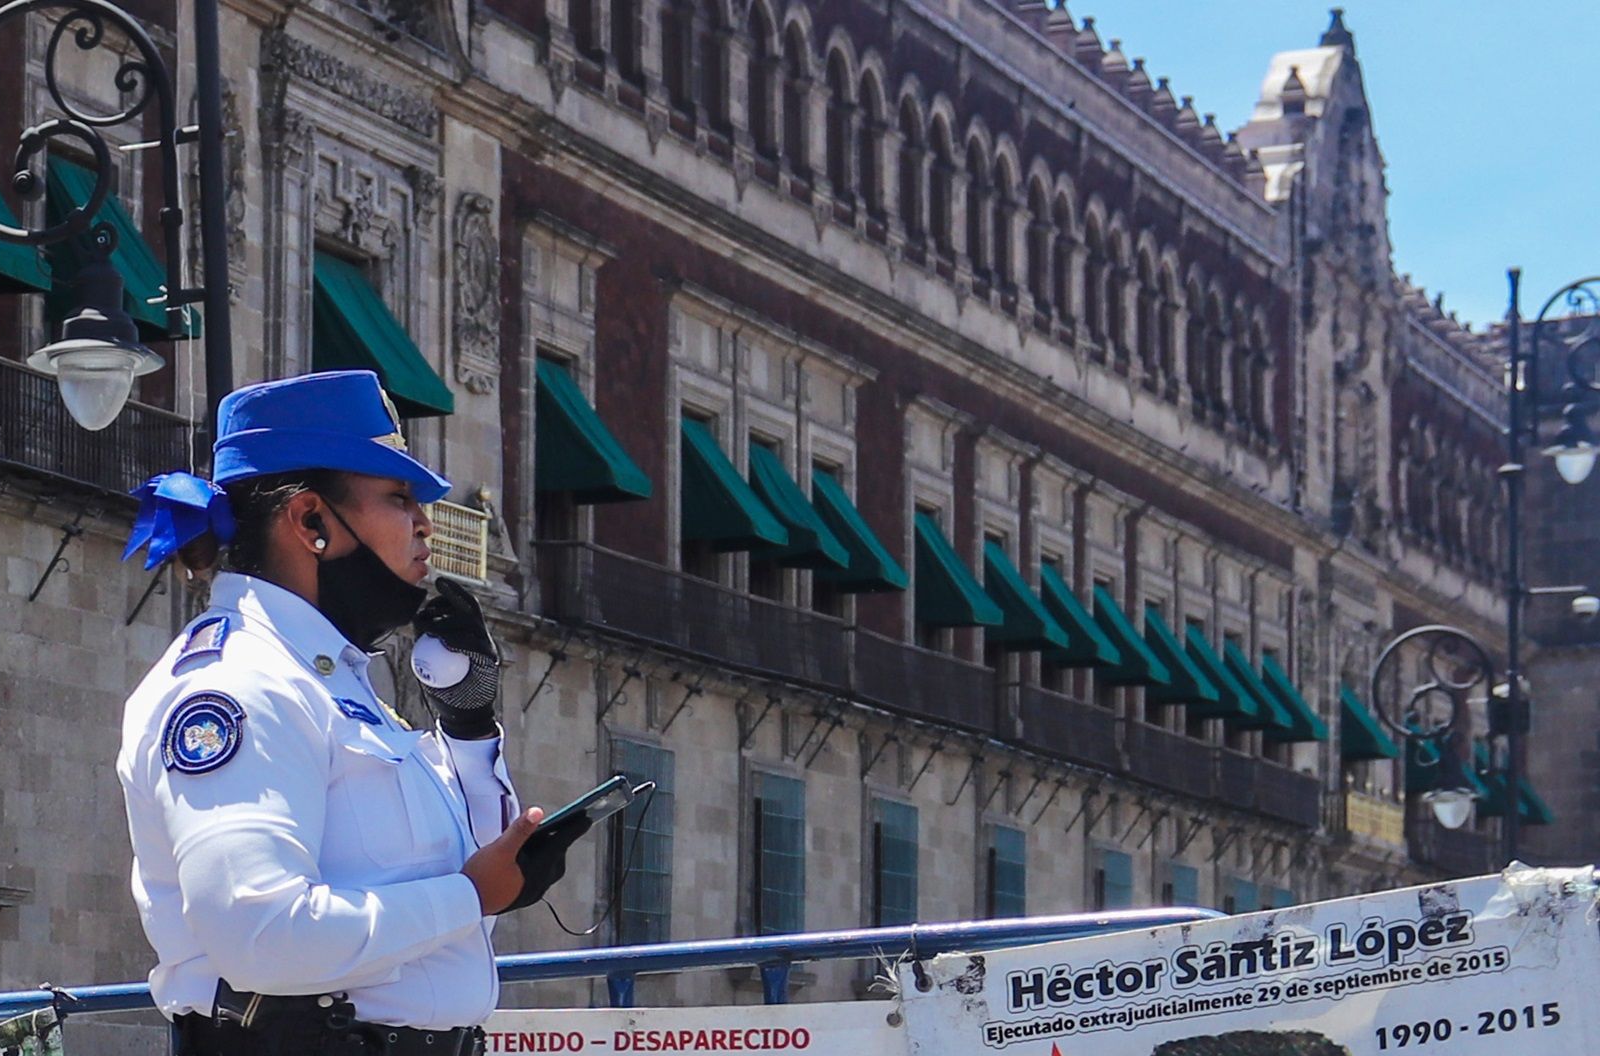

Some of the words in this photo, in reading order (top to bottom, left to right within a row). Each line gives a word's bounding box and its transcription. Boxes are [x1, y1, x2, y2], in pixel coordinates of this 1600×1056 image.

[987, 1017, 1075, 1043] Ejecutado
[1080, 991, 1253, 1032] extrajudicialmente
[1262, 985, 1280, 1001] 29
[1286, 980, 1308, 998] de
[1314, 966, 1422, 995] septiembre
[1427, 961, 1450, 977] de
[1457, 951, 1505, 972] 2015
[1011, 963, 1163, 1009] Héctor
[1175, 936, 1315, 985] Sántiz
[1330, 915, 1470, 965] López
[483, 1031, 584, 1053] TENIDO
[614, 1028, 810, 1052] DESAPARECIDO
[1376, 1018, 1451, 1051] 1990
[1477, 1002, 1561, 1036] 2015
